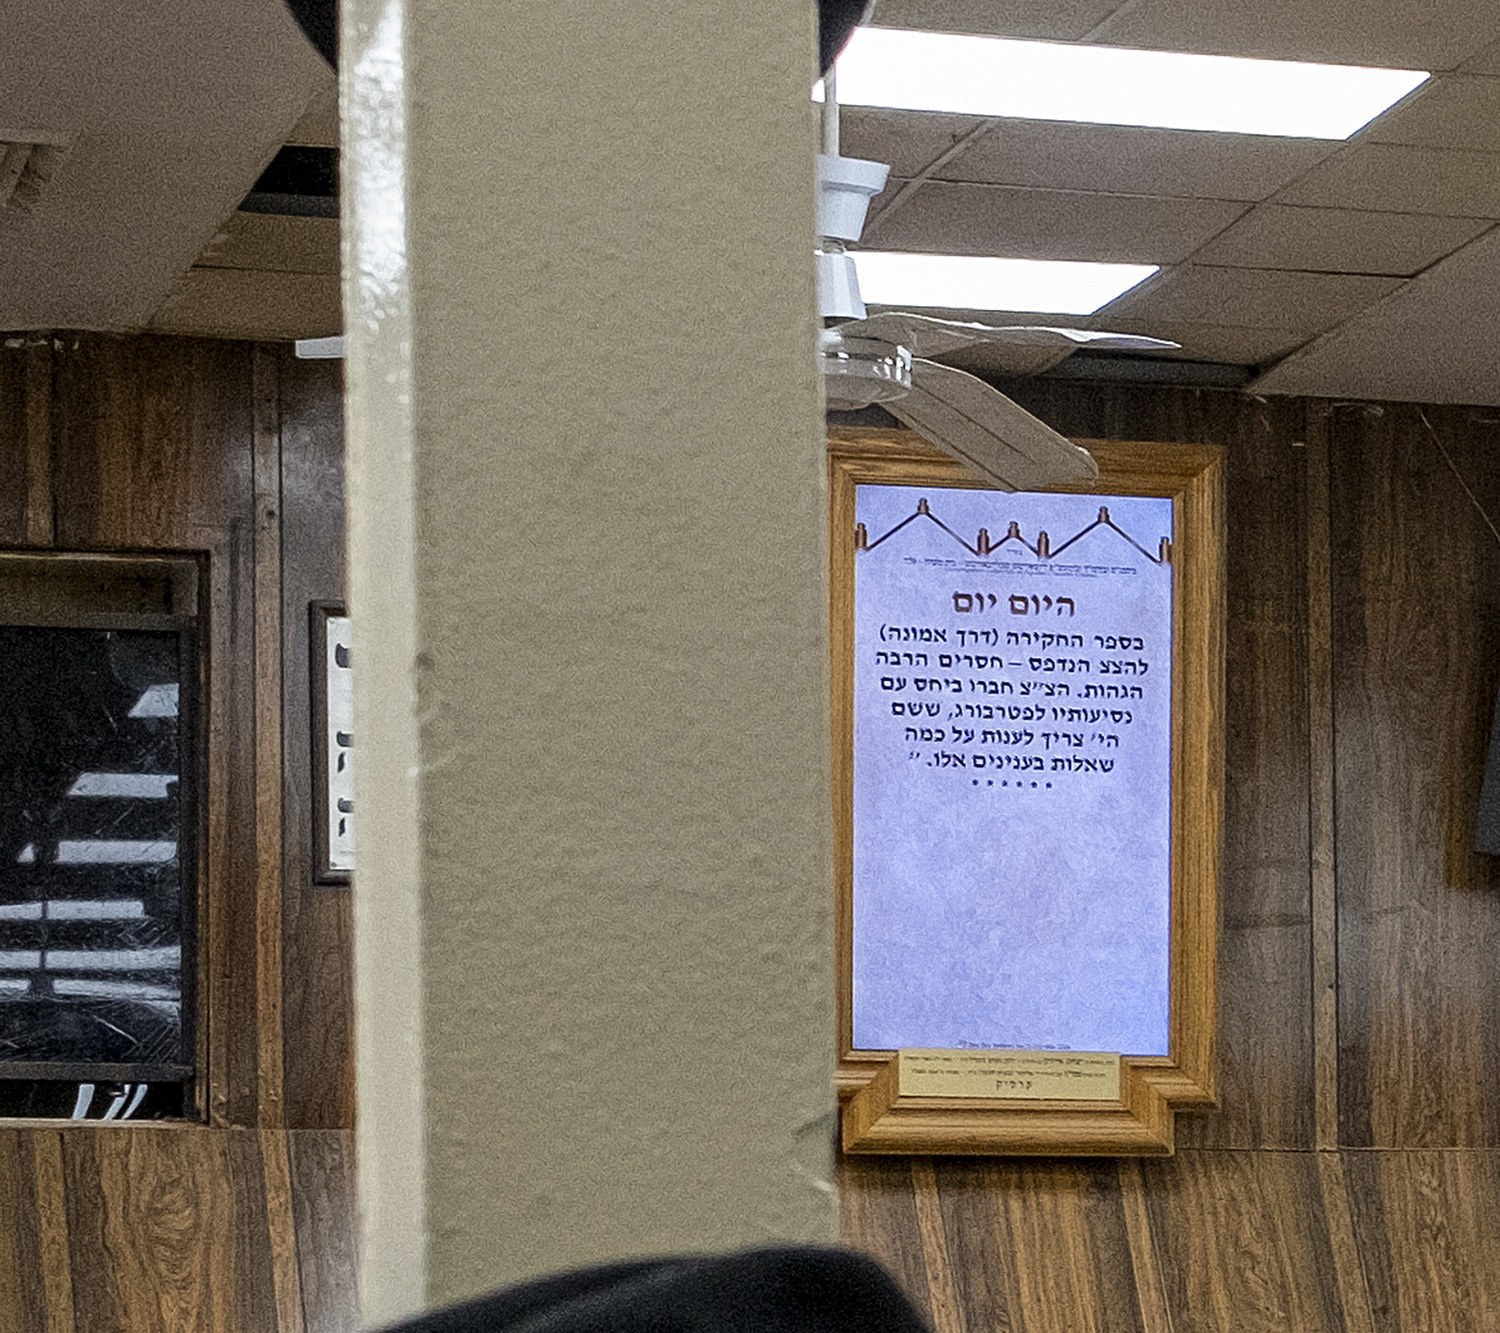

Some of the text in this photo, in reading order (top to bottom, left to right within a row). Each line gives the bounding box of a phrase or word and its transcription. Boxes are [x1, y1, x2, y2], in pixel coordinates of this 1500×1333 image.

[953, 591, 1075, 617] היום יום
[879, 623, 1144, 650] בספר החקירה (דרך אמונה)
[876, 651, 928, 666] הרבה
[938, 653, 1003, 669] חסרים
[1029, 656, 1090, 673] הנדפס
[880, 676, 907, 692] עם
[913, 677, 963, 693] ביחס
[891, 702, 940, 717] ששם
[1052, 706, 1133, 724] נסיעותיו
[905, 727, 945, 743] כמה
[952, 726, 975, 744] על
[981, 729, 1034, 745] לענות
[1041, 731, 1084, 749] צריך
[972, 754, 1045, 771] בענינים
[1051, 755, 1114, 773] שאלות
